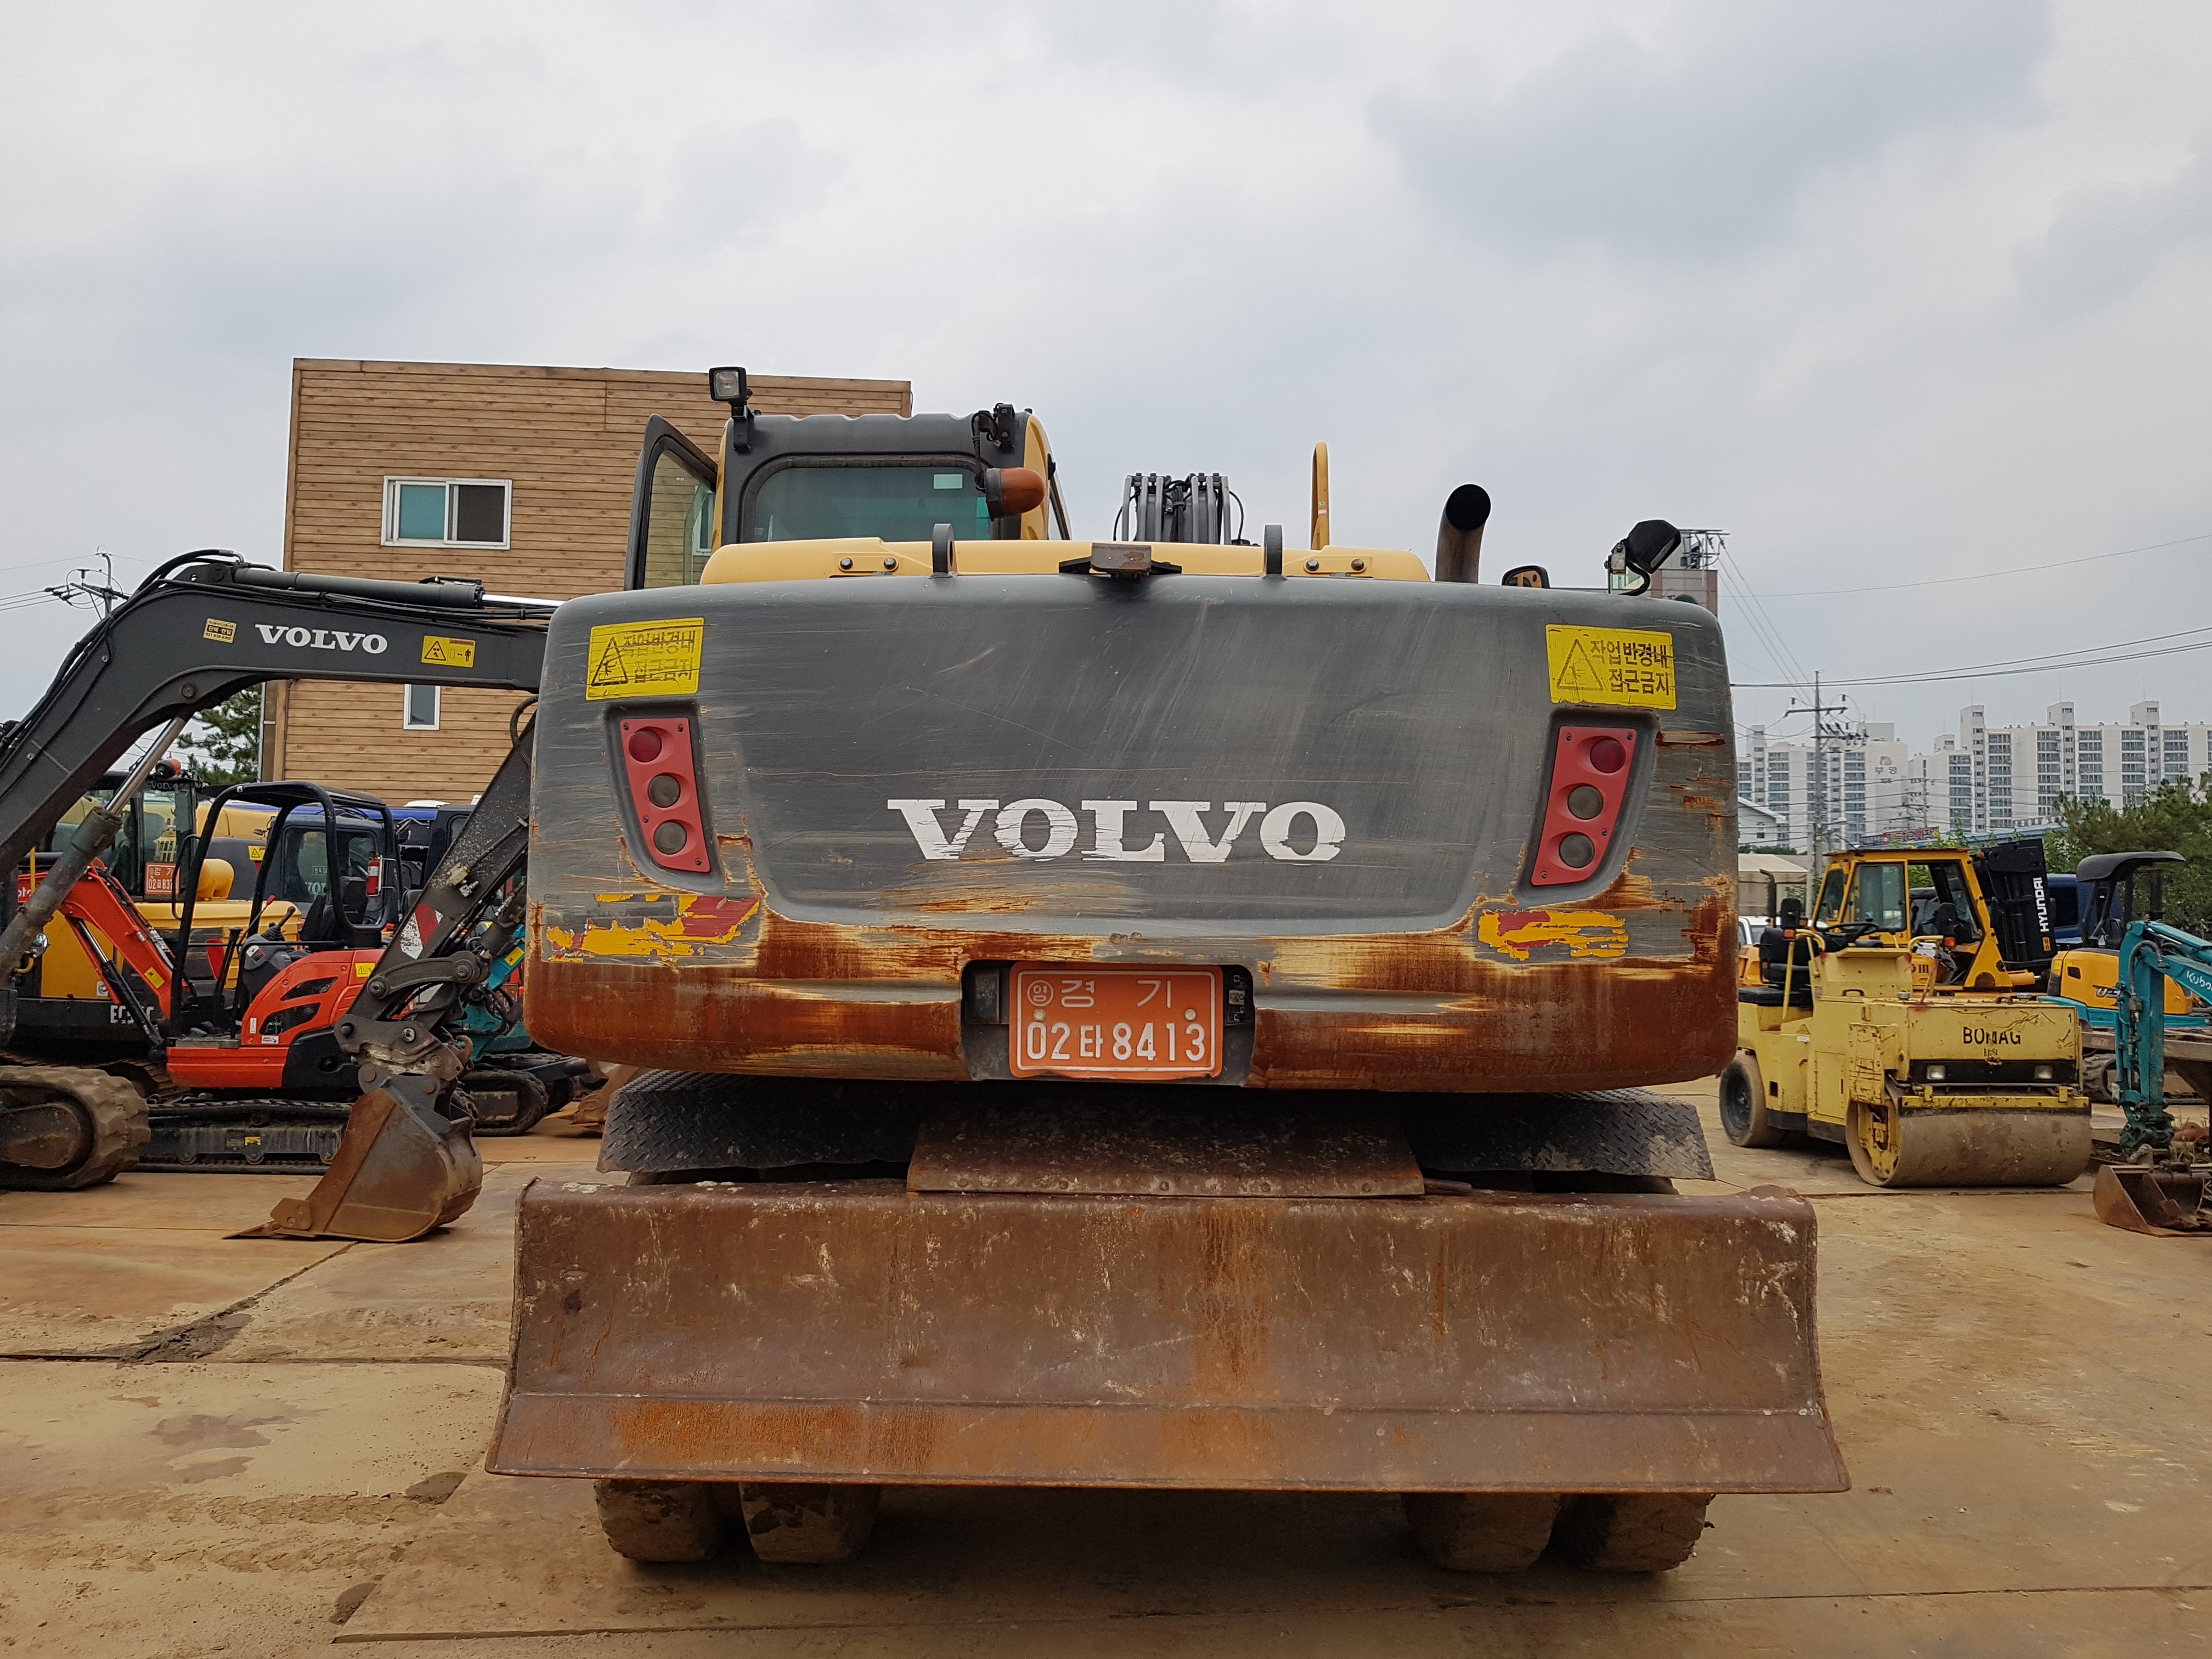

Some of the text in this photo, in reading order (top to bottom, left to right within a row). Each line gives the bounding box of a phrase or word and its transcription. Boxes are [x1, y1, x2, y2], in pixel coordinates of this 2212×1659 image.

[255, 624, 387, 654] VOLVO
[1590, 640, 1668, 668] 작업반경내
[1609, 668, 1669, 696] 접근금지
[887, 798, 1346, 865] VOLVO
[2033, 877, 2050, 932] HYUNDAI
[2186, 970, 2212, 991] Kubo
[1027, 1021, 1205, 1061] 02타8413
